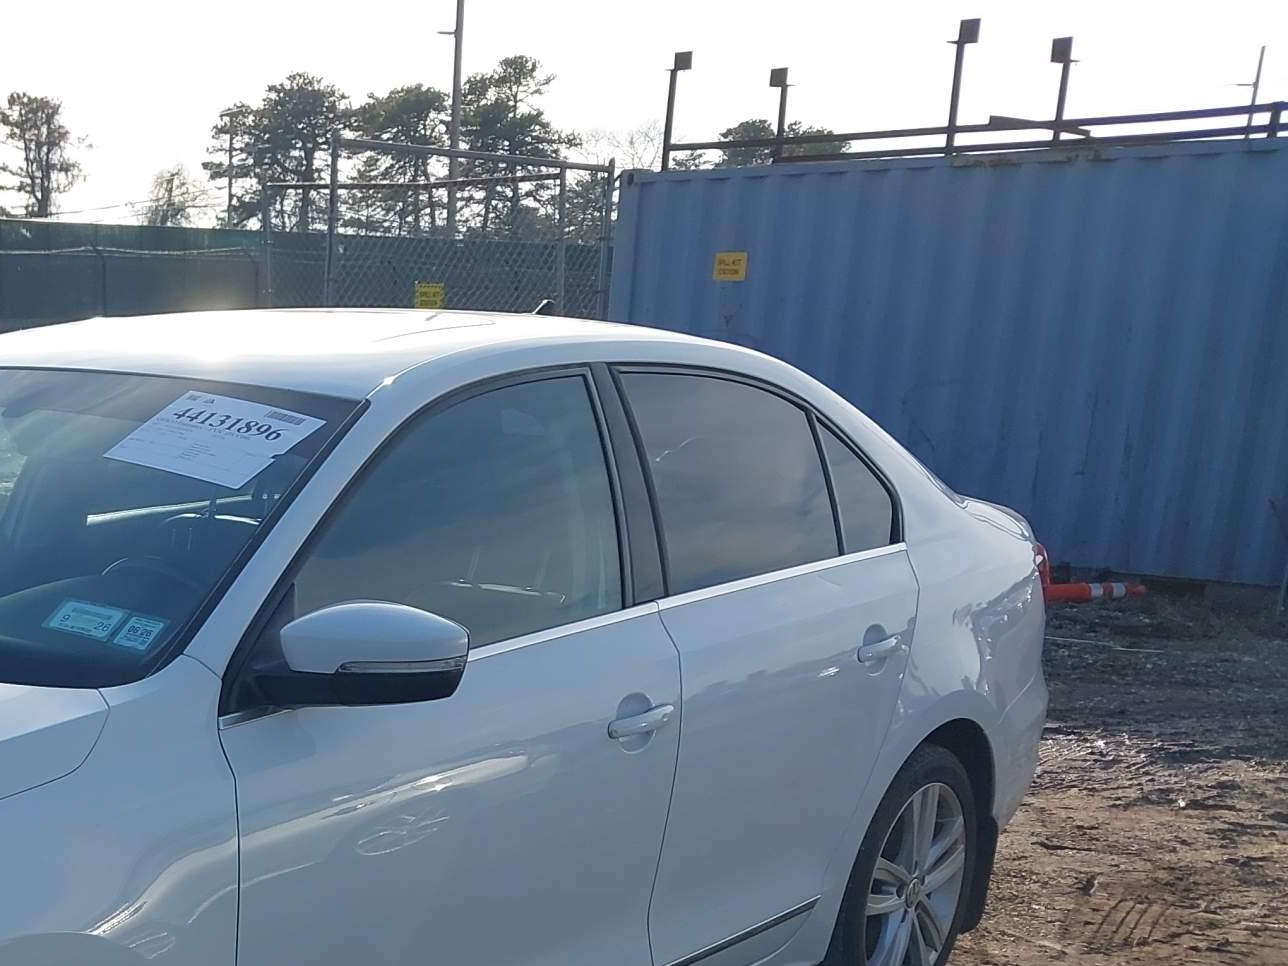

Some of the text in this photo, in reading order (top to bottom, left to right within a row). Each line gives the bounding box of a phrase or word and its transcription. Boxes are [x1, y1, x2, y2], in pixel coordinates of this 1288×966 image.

[173, 407, 289, 441] 44131896
[61, 614, 72, 623] 9
[93, 621, 112, 633] 26
